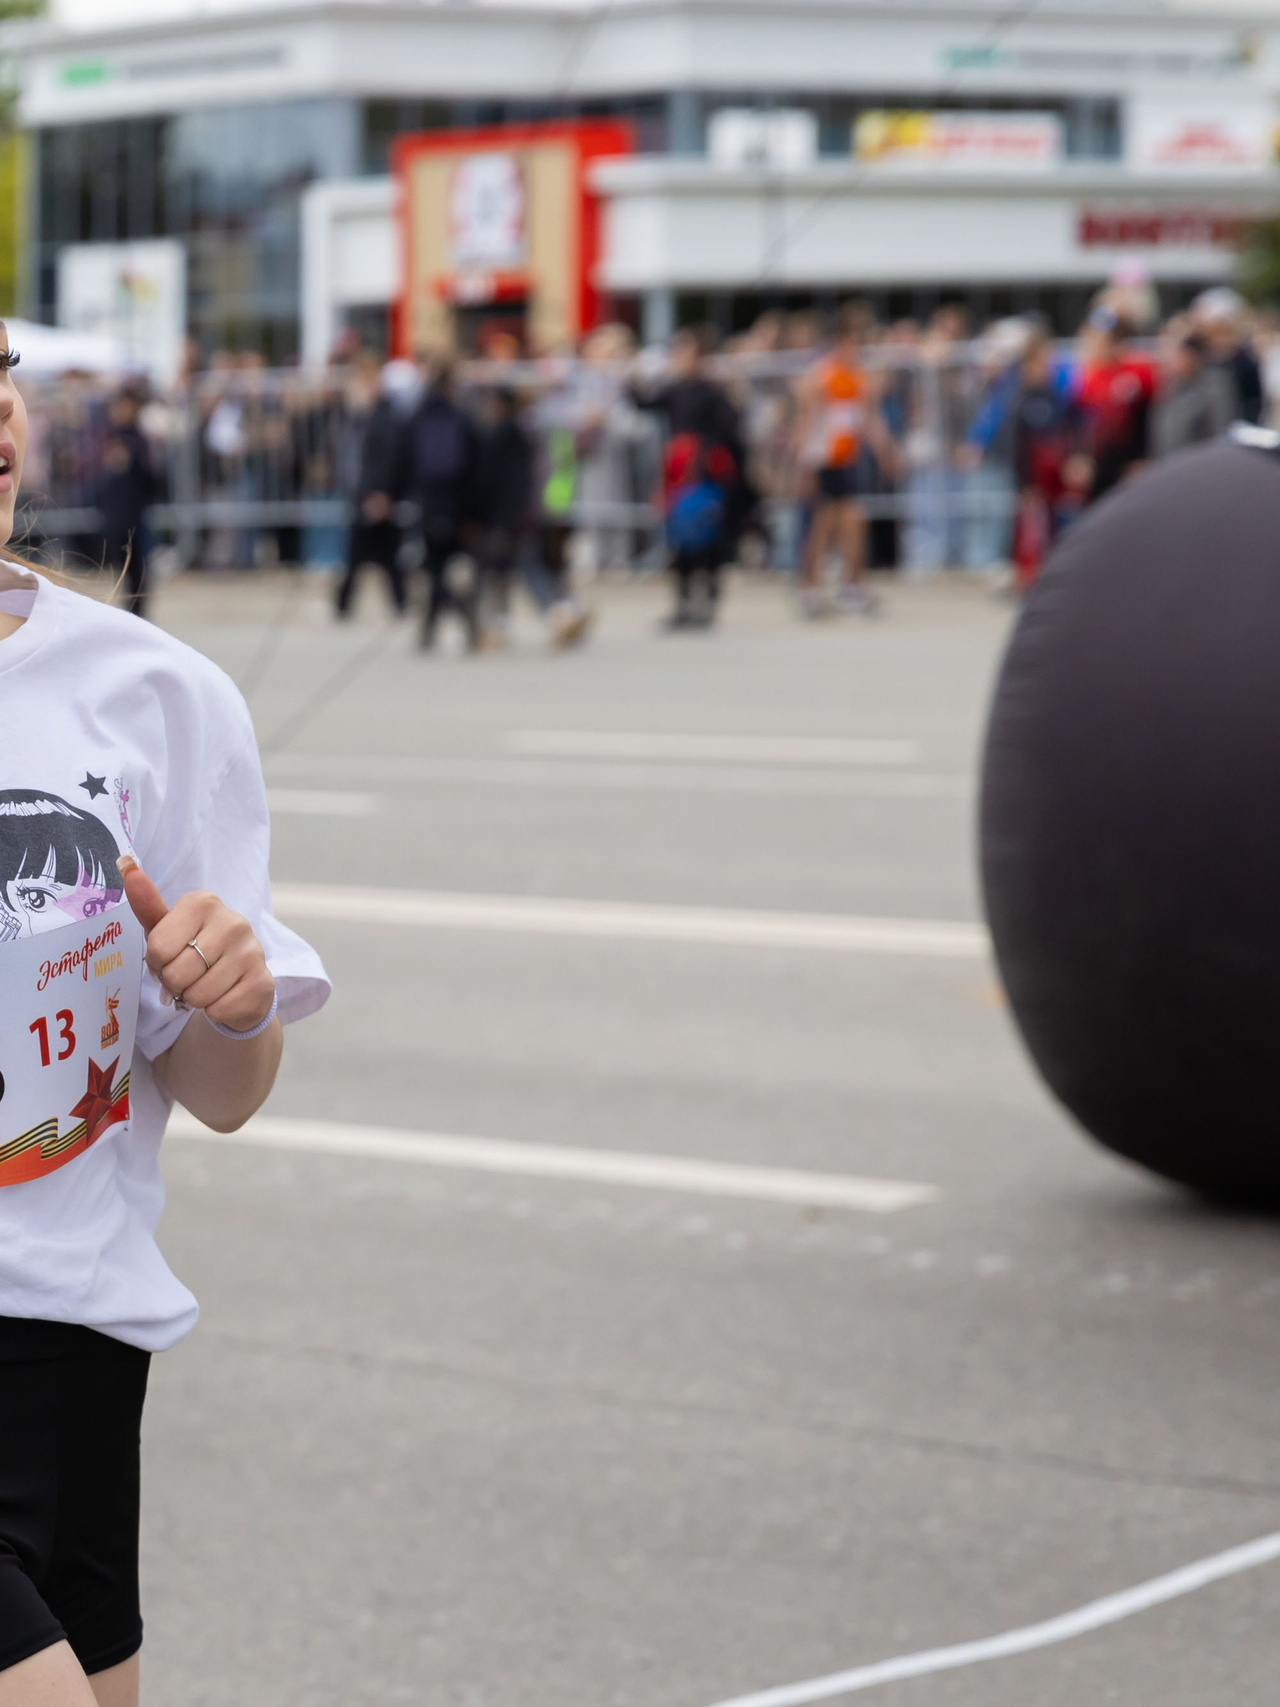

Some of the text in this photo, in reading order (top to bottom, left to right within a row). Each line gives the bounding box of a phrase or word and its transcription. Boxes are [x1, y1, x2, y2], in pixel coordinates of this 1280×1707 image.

[36, 921, 123, 992] Эстафета
[93, 950, 123, 979] МИРА
[29, 1008, 76, 1068] 13
